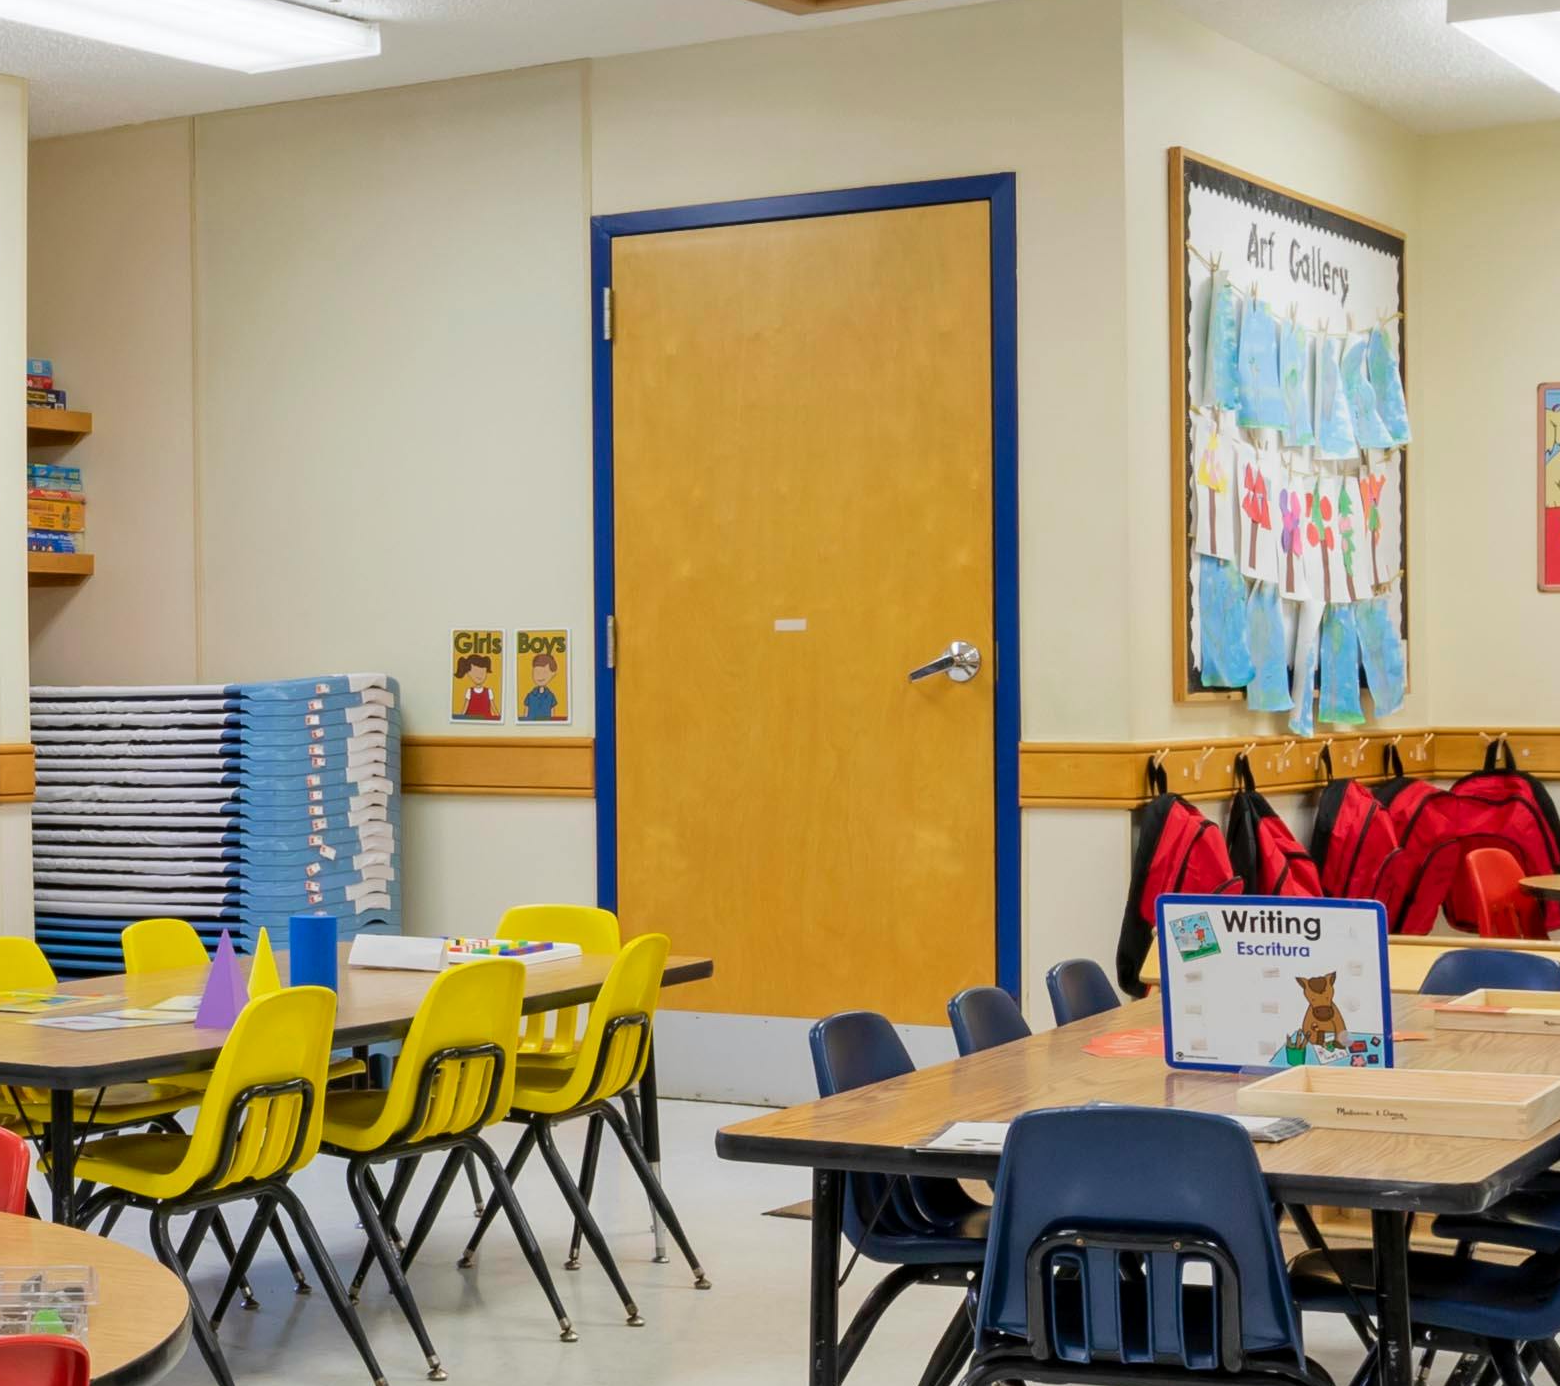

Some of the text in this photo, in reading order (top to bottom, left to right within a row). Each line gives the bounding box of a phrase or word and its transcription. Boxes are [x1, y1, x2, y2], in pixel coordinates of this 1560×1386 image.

[1247, 221, 1349, 305] Art Gallery
[454, 632, 502, 654] Girls
[518, 632, 566, 656] Boys
[1222, 911, 1322, 941] Writing
[1237, 941, 1310, 958] Escritura
